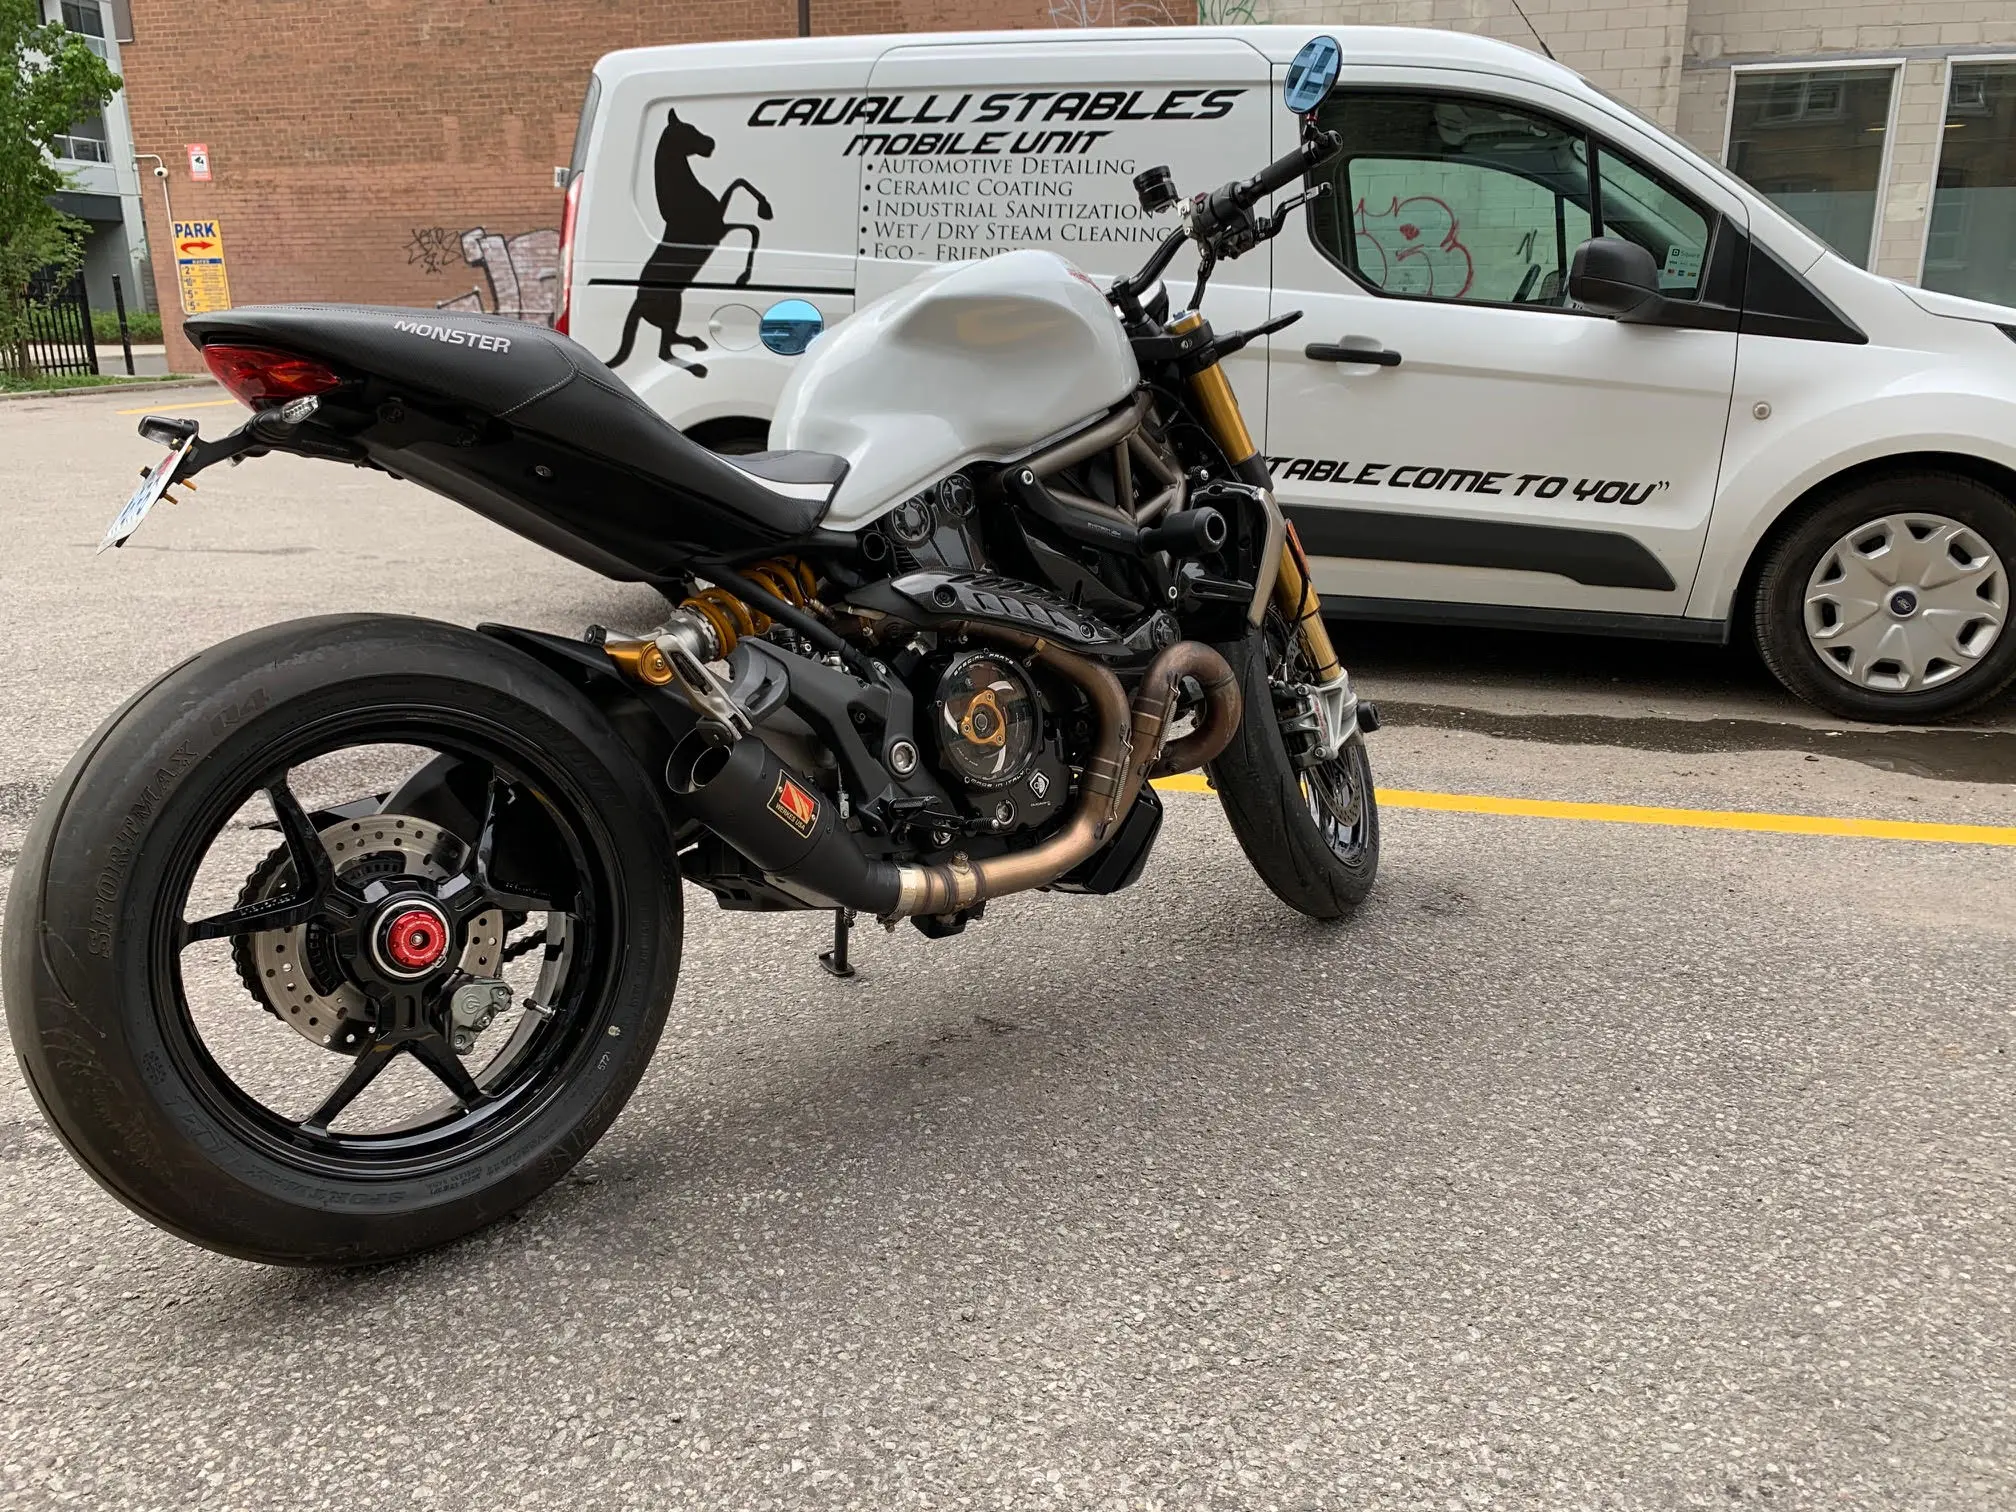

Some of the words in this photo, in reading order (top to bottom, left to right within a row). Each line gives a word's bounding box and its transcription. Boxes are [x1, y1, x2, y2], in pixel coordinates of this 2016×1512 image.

[971, 89, 1250, 123] STABLES
[842, 131, 1013, 157] MOBILE
[1009, 130, 1114, 155] UNIT
[878, 157, 1013, 175] AUTOMOTIVE
[1022, 156, 1136, 176] DETAILING
[876, 178, 970, 196] CERAMIC
[977, 178, 1073, 197] COATING
[876, 200, 998, 218] INDUSTRIAL
[174, 222, 216, 239] PARK
[874, 221, 919, 239] WET
[937, 222, 979, 241] DRY
[986, 222, 1052, 241] STEAM
[394, 320, 511, 354] MONSTER
[1263, 455, 1388, 486] TABLE
[1388, 466, 1515, 494] COME
[1514, 474, 1568, 499] TO
